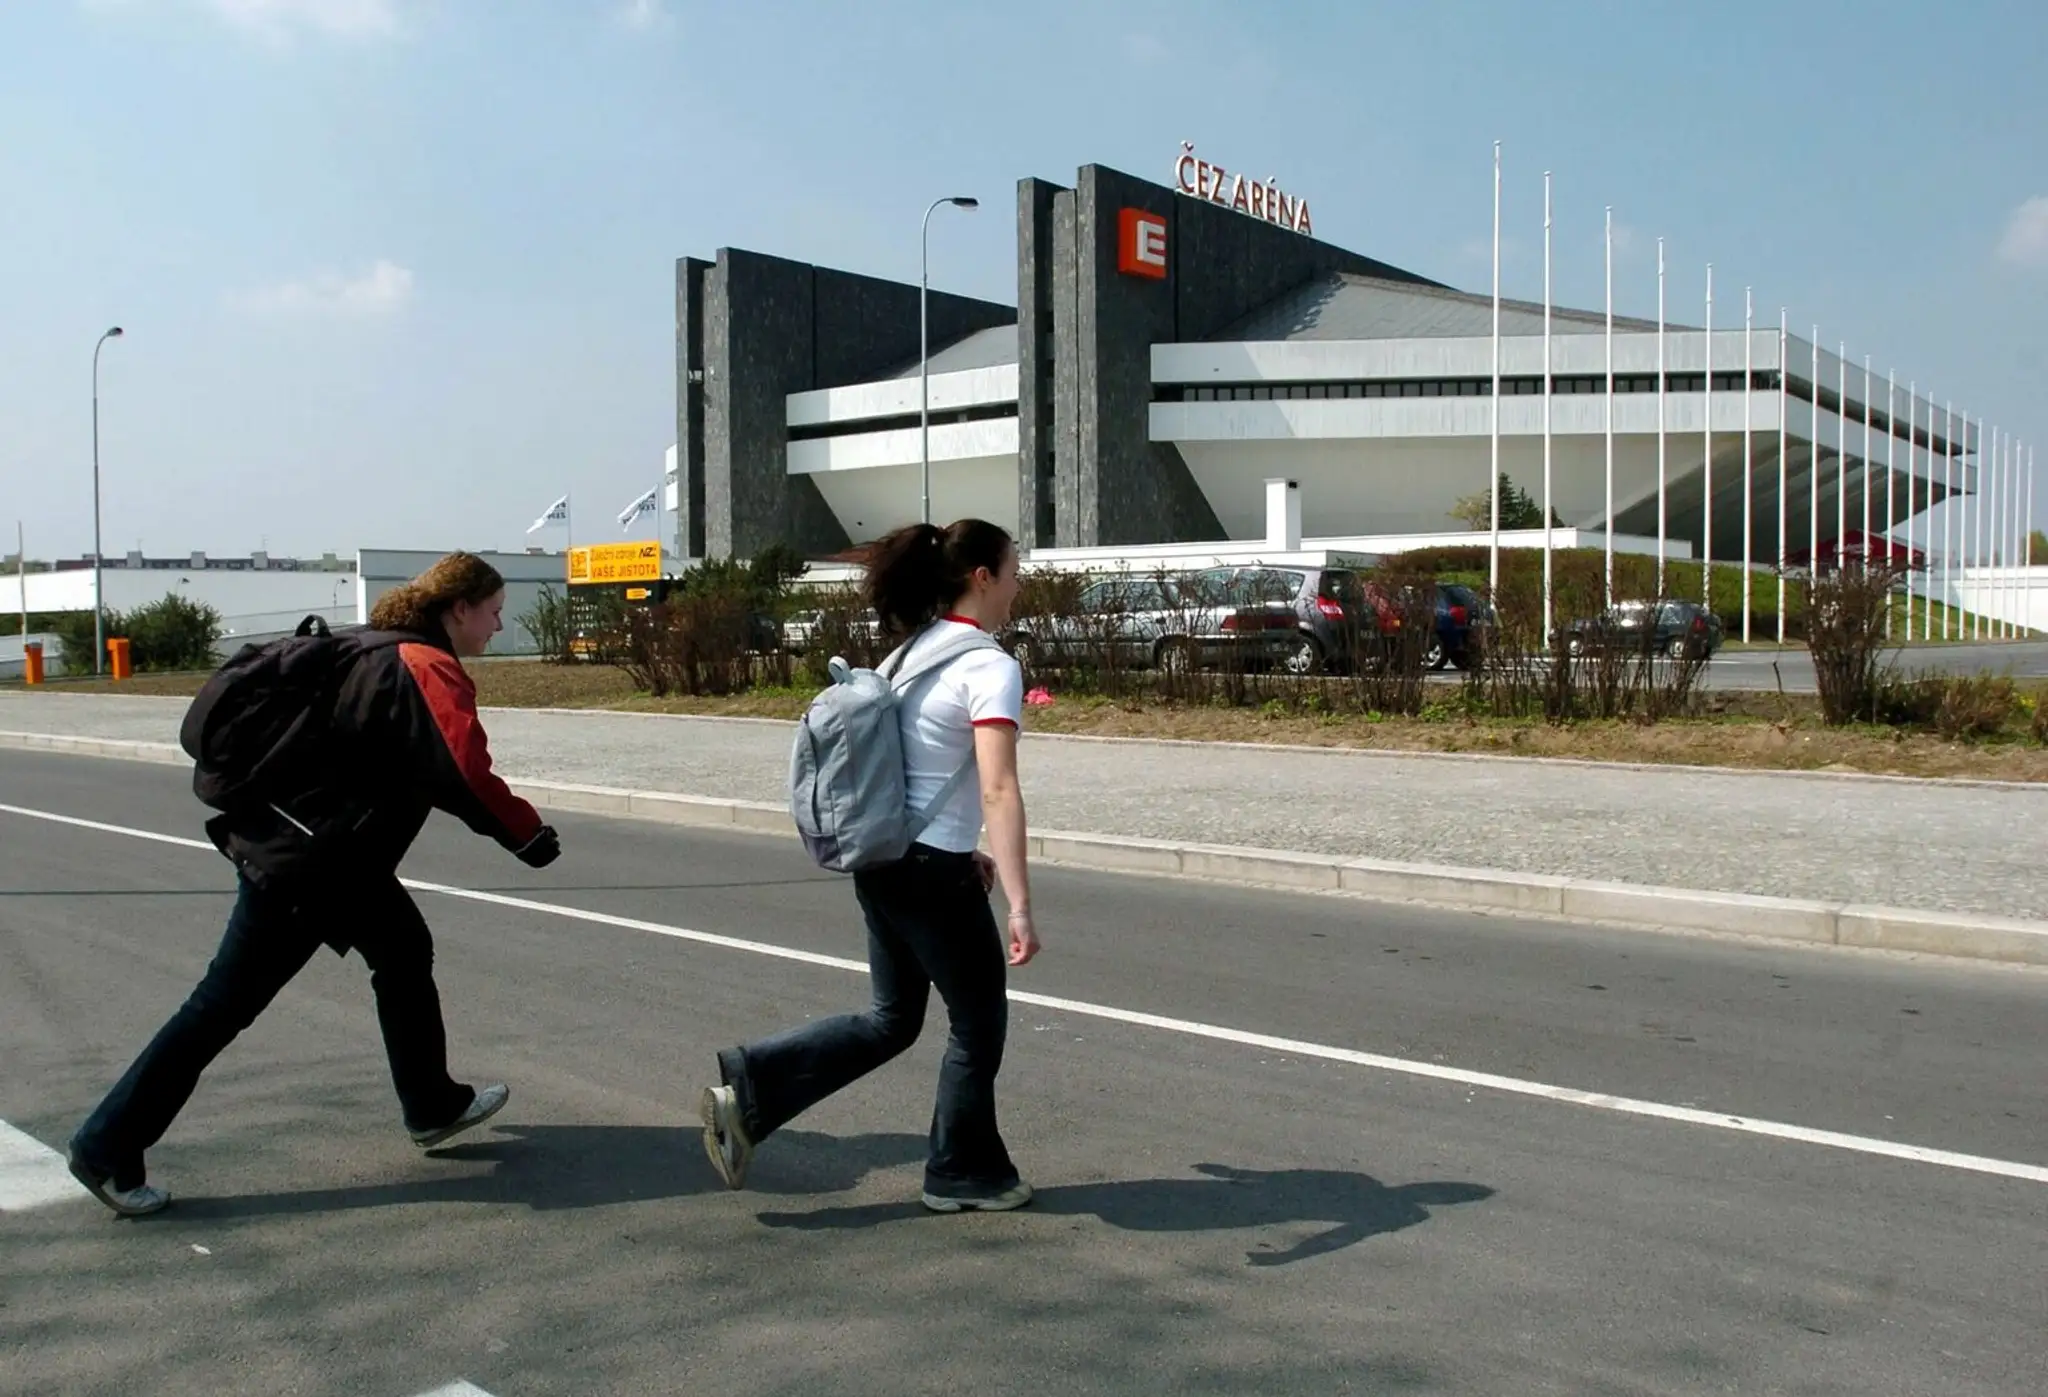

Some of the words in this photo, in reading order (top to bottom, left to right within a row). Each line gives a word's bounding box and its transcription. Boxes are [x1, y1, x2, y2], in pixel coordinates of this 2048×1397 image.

[1175, 140, 1226, 204] ČEZ
[1232, 174, 1312, 236] ARÉNA
[618, 563, 657, 577] JISTOTA
